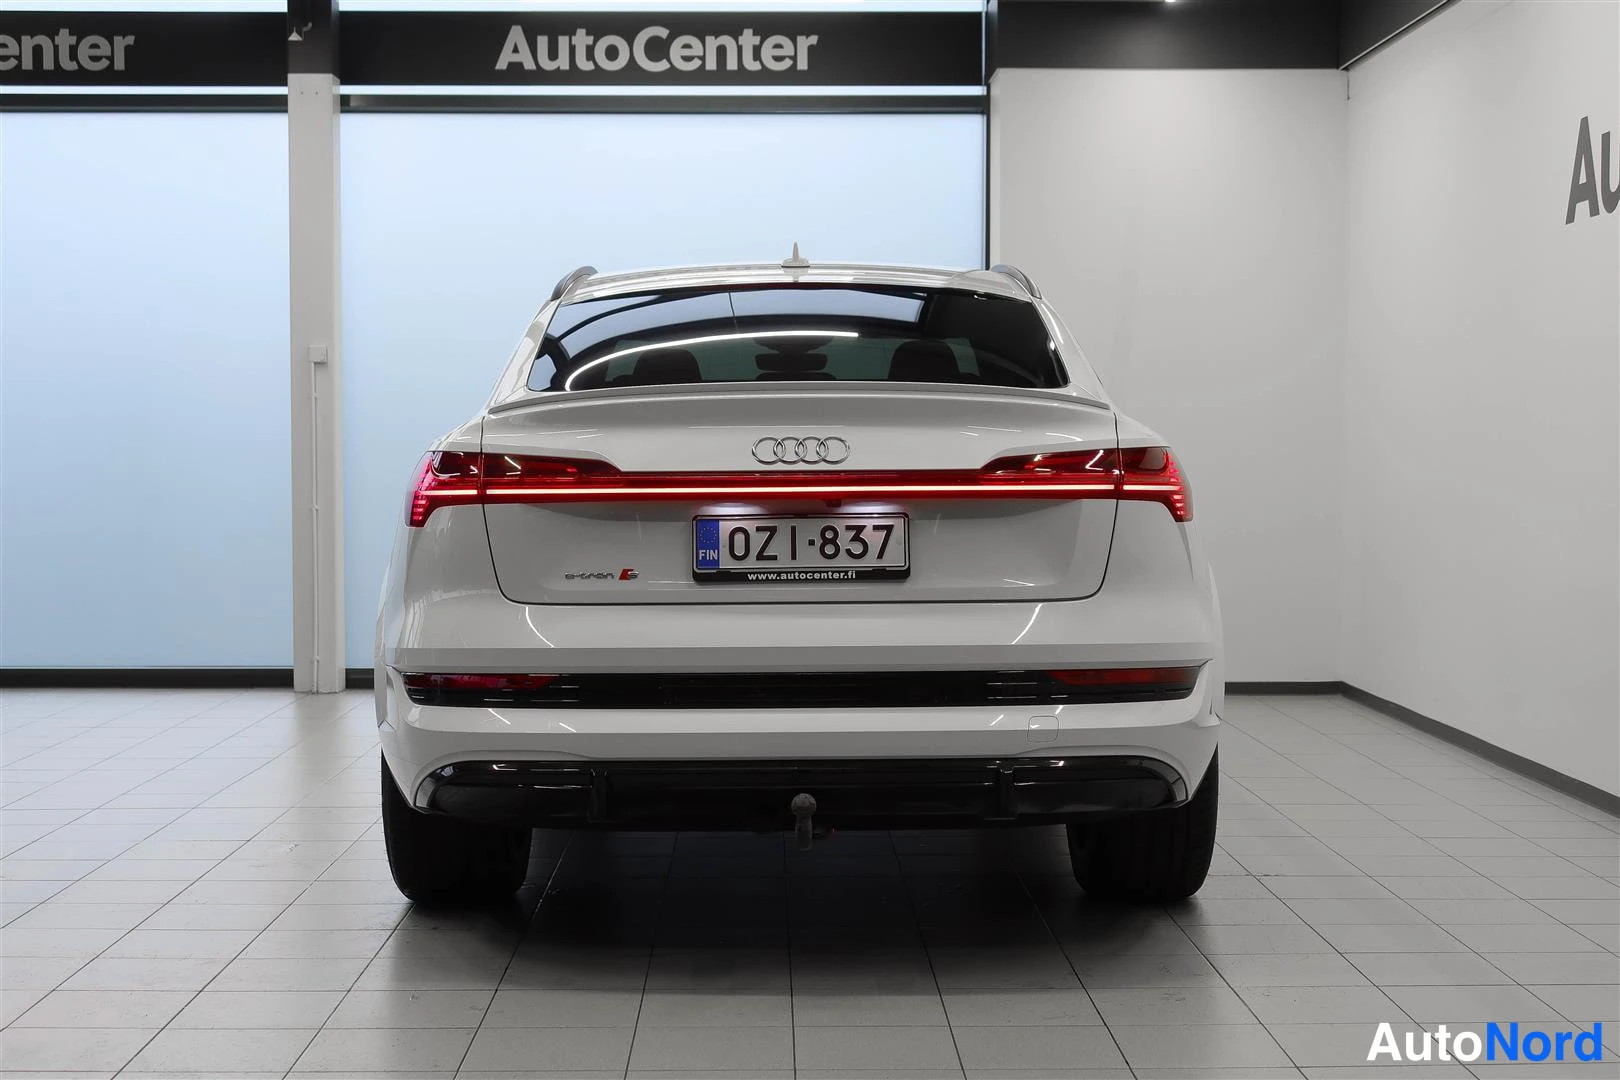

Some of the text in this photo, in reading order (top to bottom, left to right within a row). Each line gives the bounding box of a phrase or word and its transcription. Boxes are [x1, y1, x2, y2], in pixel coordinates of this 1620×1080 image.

[494, 25, 819, 72] AutoCenter
[699, 549, 718, 561] FIN
[747, 570, 856, 580] www.autocenter.fi
